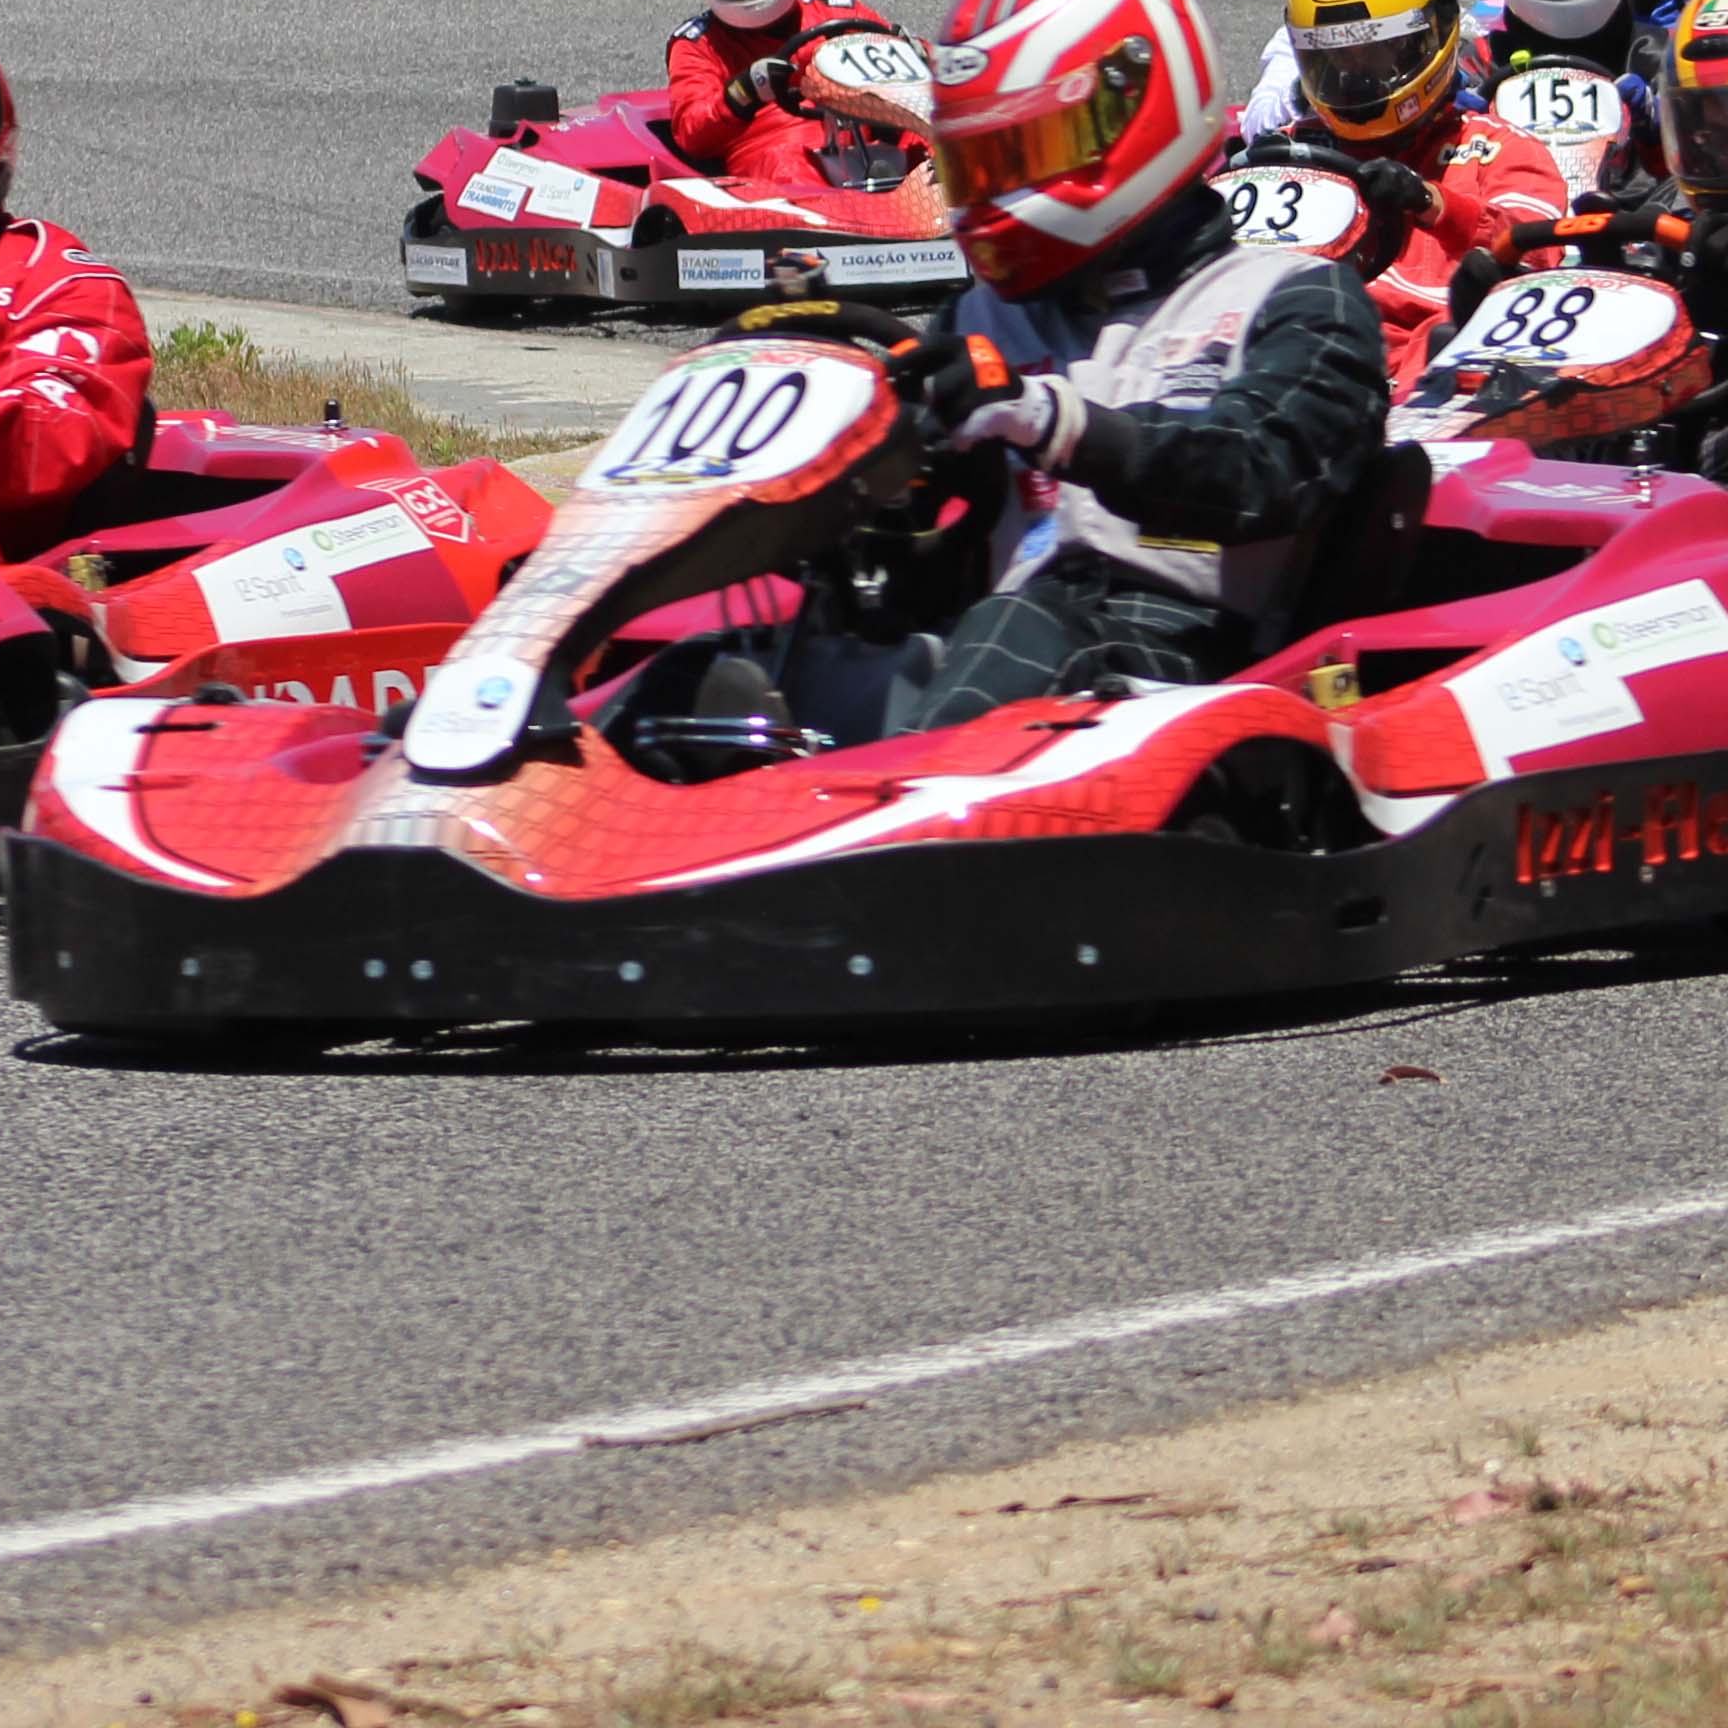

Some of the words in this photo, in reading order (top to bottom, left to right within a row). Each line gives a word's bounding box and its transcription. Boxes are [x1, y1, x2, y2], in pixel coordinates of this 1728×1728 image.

[841, 44, 924, 82] 161
[1519, 79, 1599, 121] 151
[681, 268, 761, 281] TRANSBRITO
[682, 257, 719, 269] STAND
[909, 251, 956, 264] VELOZ
[1482, 287, 1595, 347] 88
[629, 368, 807, 461] 100
